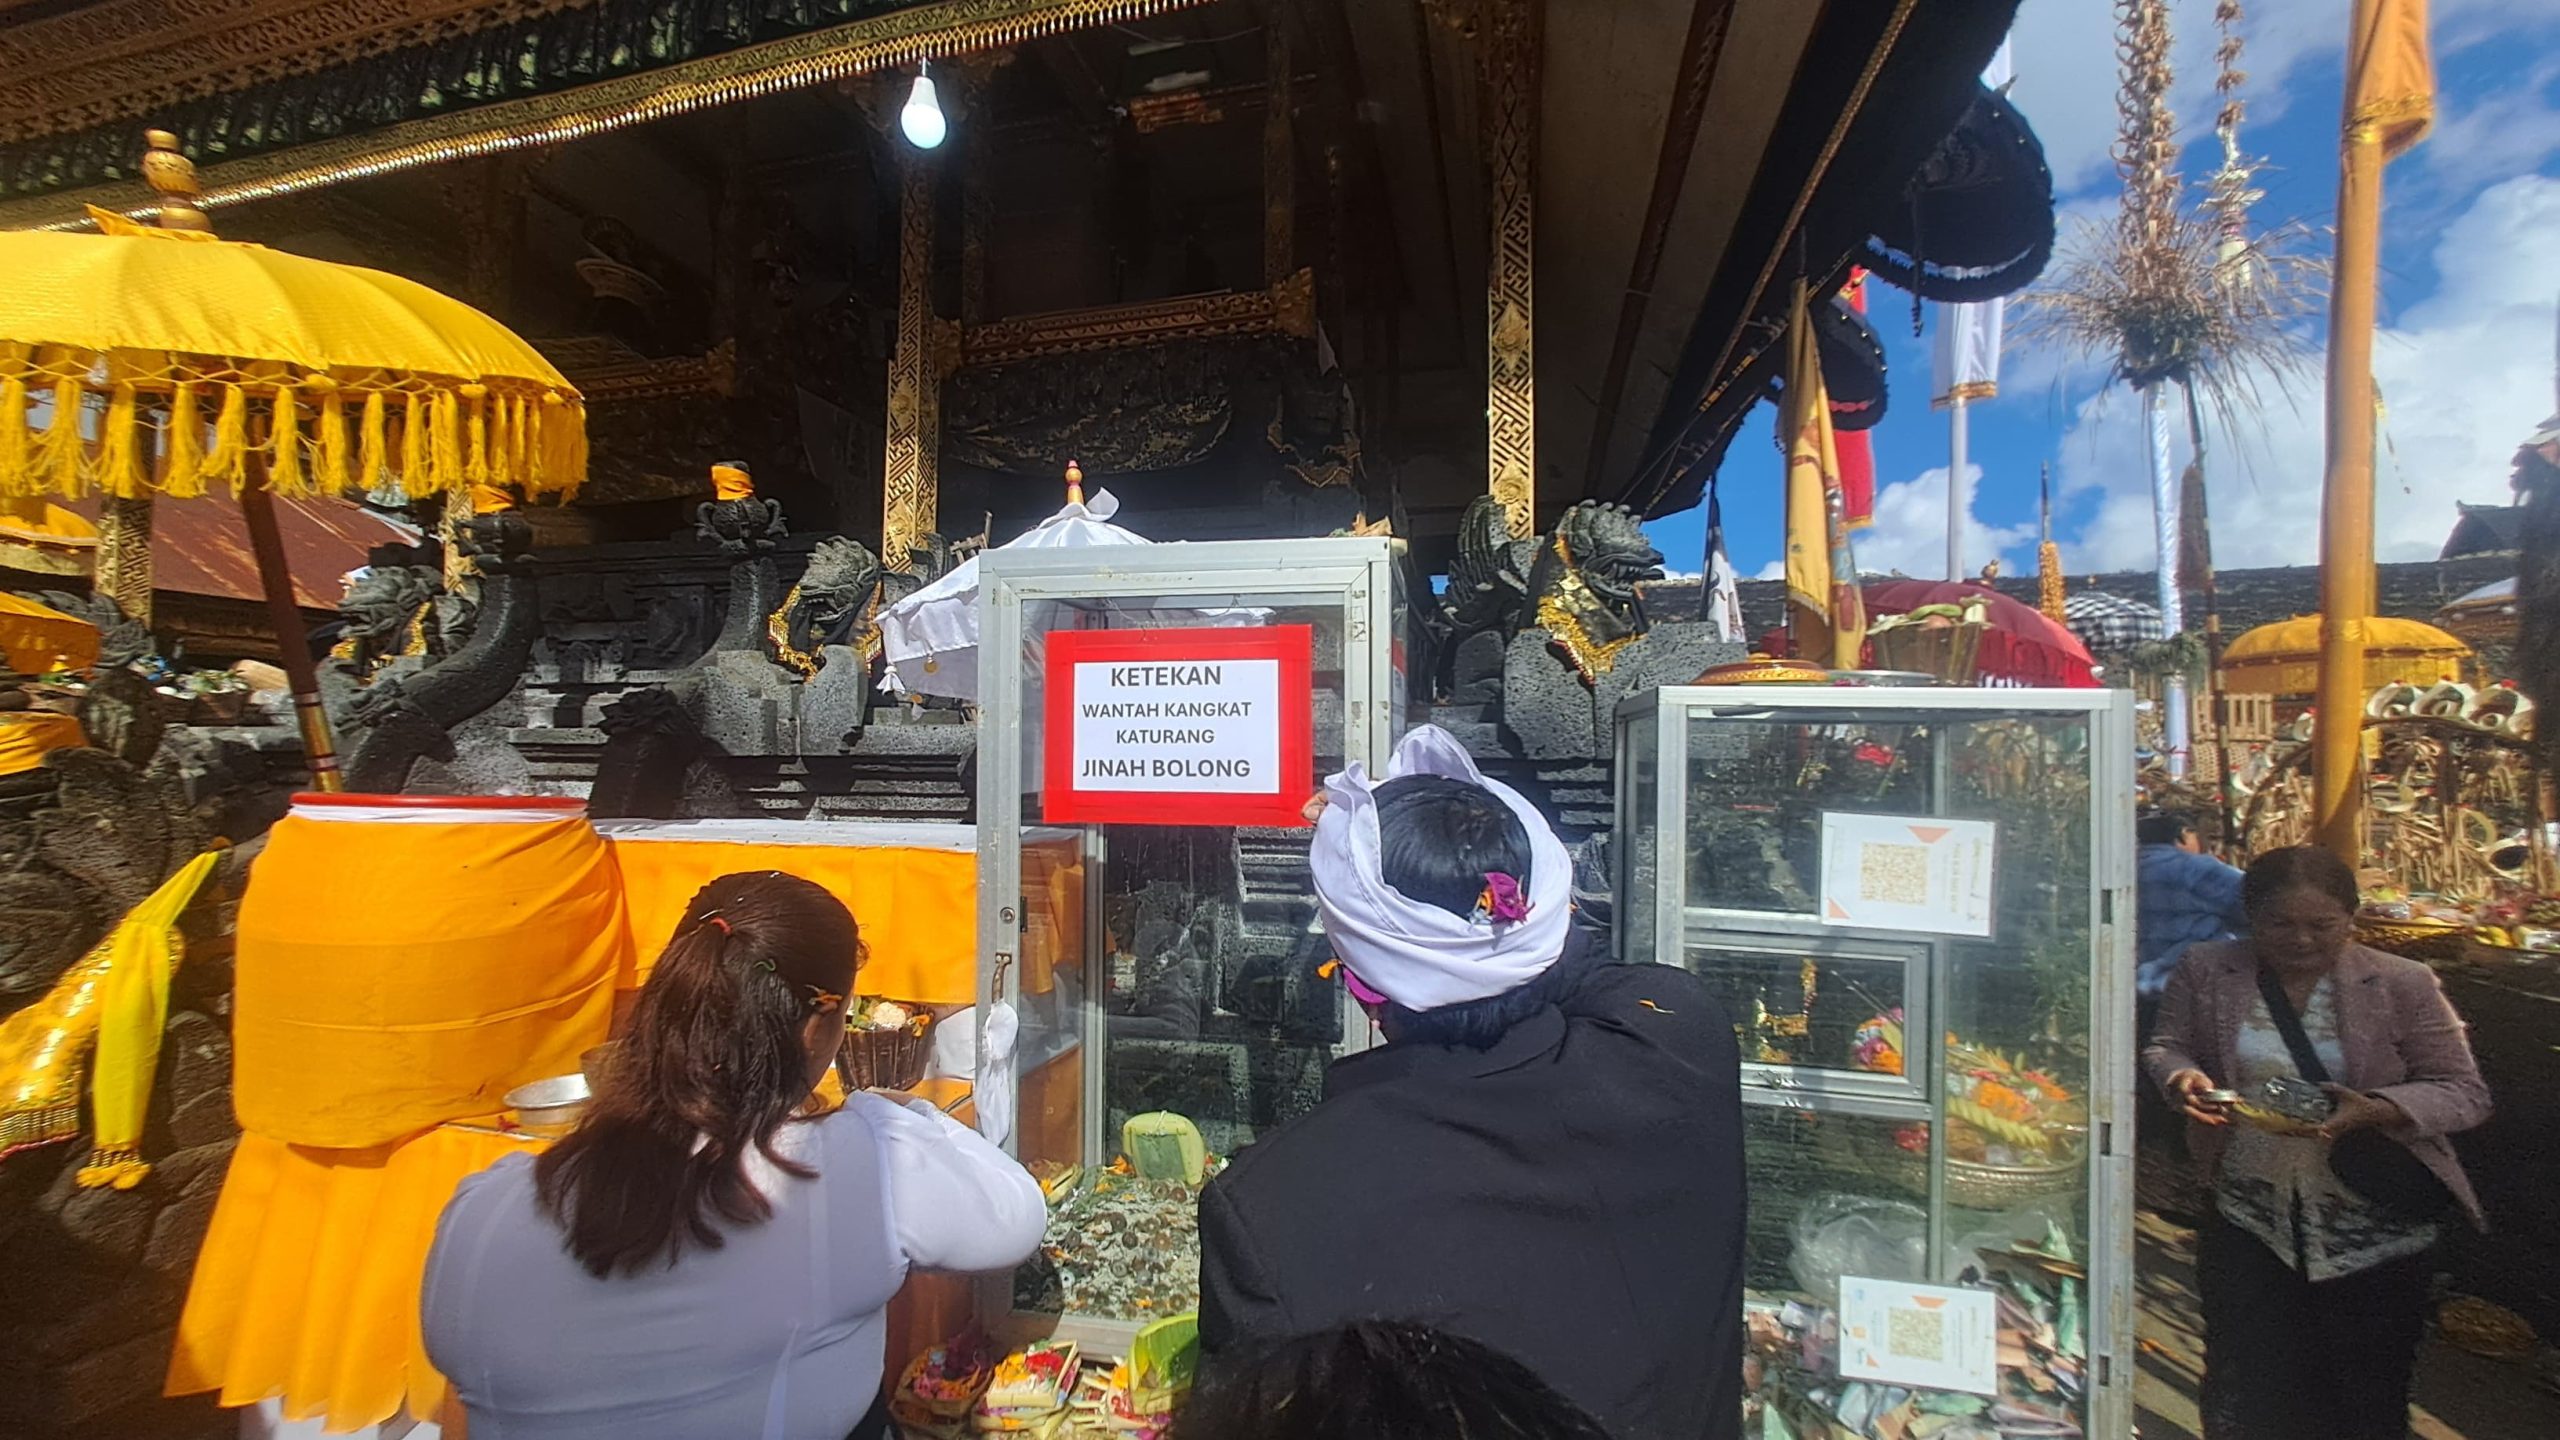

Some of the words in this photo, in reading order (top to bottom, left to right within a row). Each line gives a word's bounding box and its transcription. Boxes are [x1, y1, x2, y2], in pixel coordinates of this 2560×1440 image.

[1111, 665, 1221, 687] KETEKAN
[1082, 703, 1159, 718] WANTAH
[1164, 701, 1252, 717] KANGKAT
[1116, 729, 1215, 744] KATURANG
[1082, 759, 1146, 777] JINAH
[1152, 759, 1251, 777] BOLONG
